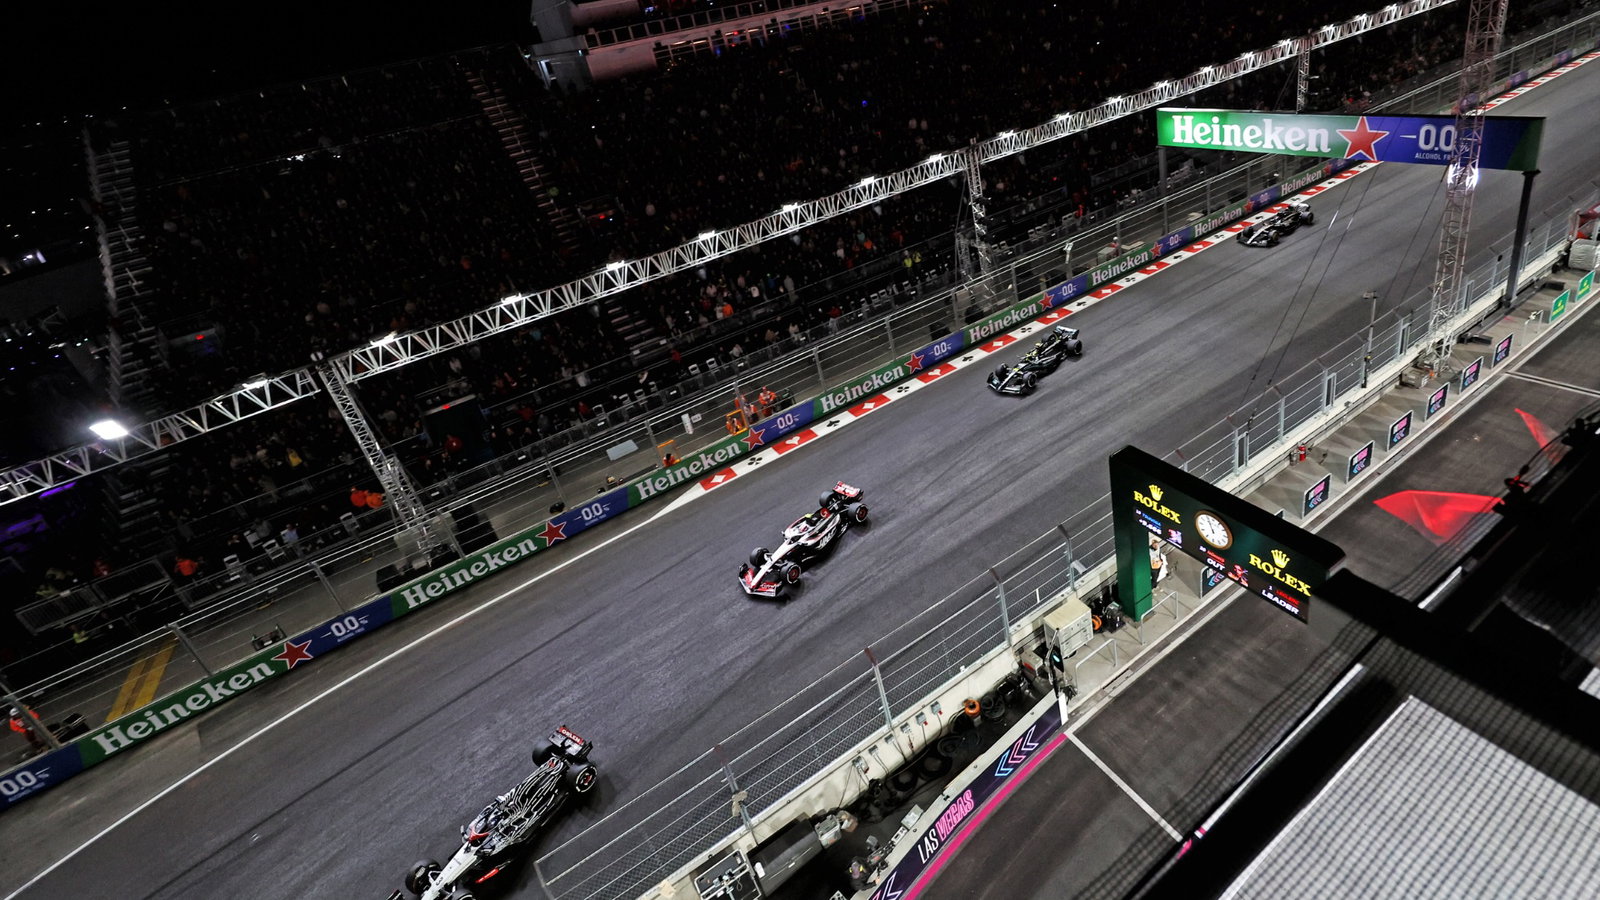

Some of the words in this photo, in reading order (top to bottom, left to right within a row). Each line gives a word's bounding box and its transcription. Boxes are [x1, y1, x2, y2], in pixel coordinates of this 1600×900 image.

[1172, 115, 1331, 153] Heineken
[1415, 152, 1441, 160] ALCOHOL
[1281, 170, 1322, 196] Heineken
[1194, 206, 1242, 238] Heineken
[1092, 250, 1149, 286] Heineken
[969, 301, 1037, 344] Heineken
[820, 363, 904, 414] Heineken
[635, 442, 741, 500] Heineken
[1133, 490, 1181, 524] ROLEX
[401, 537, 537, 609] Heineken
[1206, 557, 1226, 571] OUT
[1249, 553, 1312, 597] ROLEX
[1261, 589, 1300, 615] LEADER
[92, 662, 275, 755] Heineken
[917, 828, 939, 864] LAS
[935, 789, 975, 842] VEGAS
